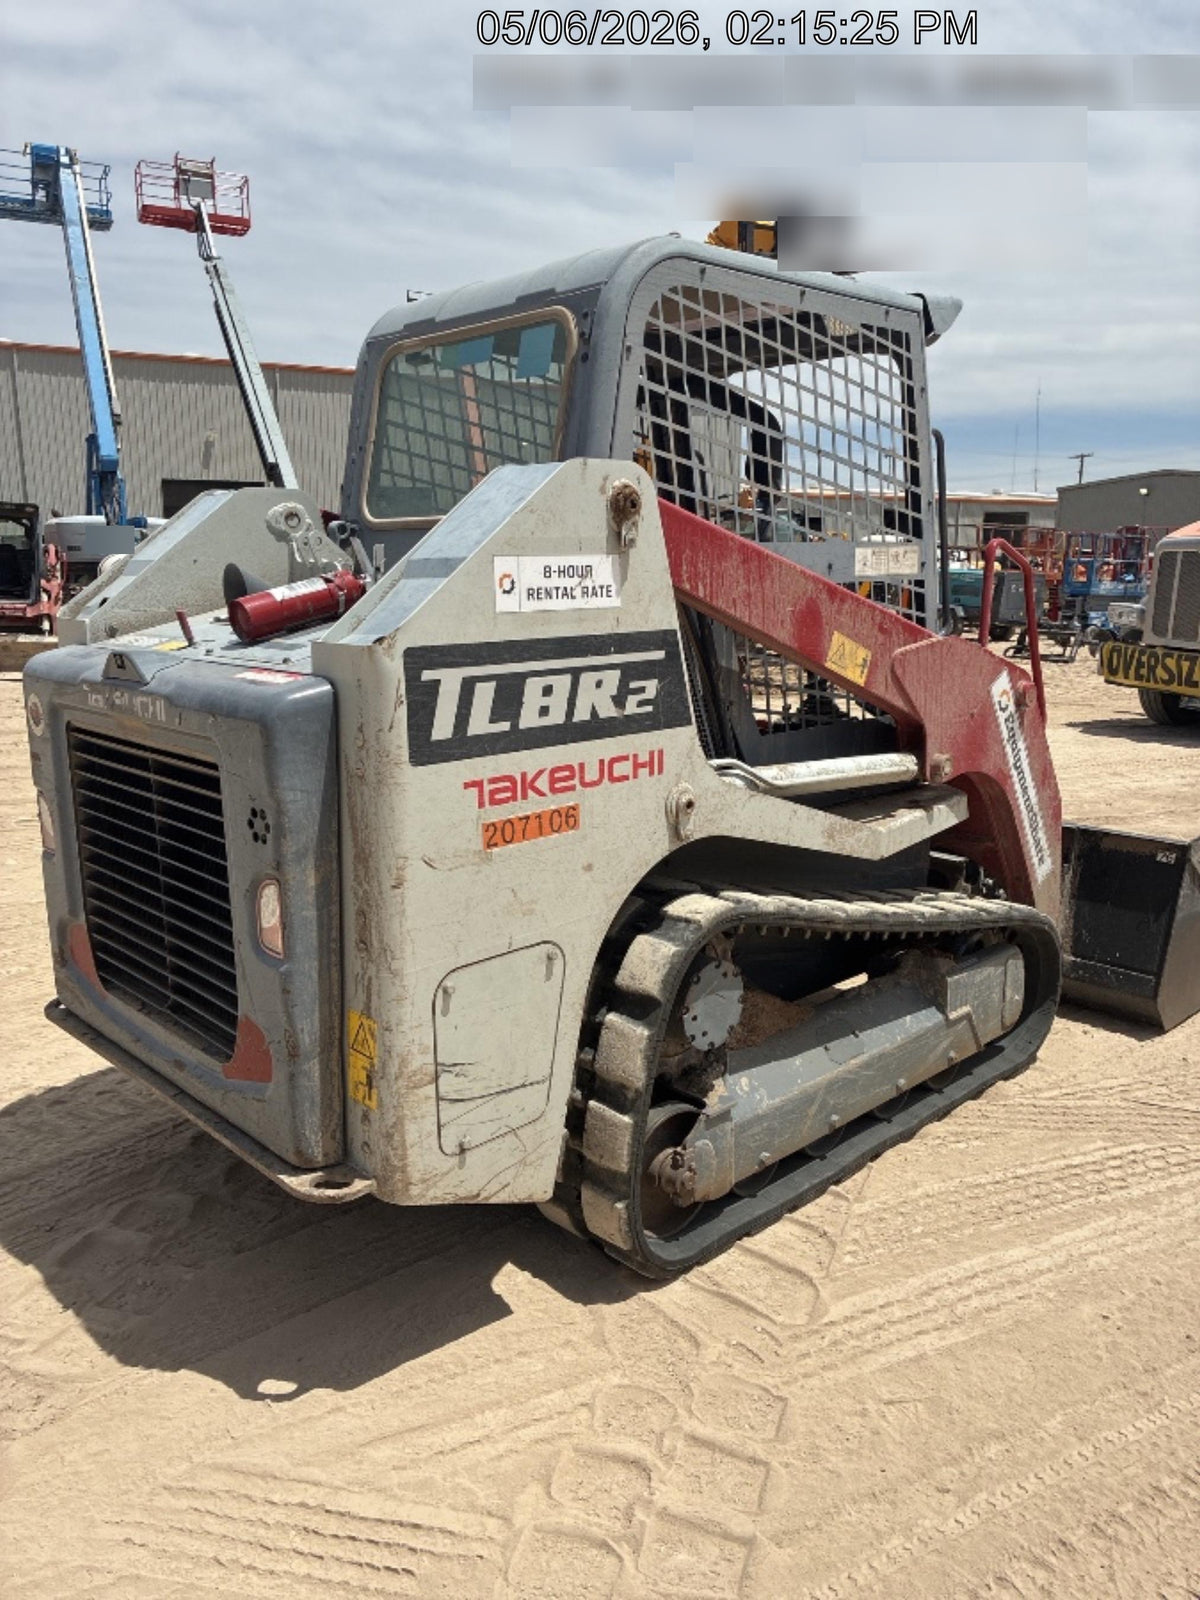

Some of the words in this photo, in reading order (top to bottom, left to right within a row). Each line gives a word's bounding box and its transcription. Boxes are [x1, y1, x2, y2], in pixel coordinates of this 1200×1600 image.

[527, 585, 577, 601] RENTAL
[581, 584, 613, 599] RATE
[543, 564, 593, 579] 8-HOUR
[420, 650, 666, 742] TL8R2
[463, 747, 665, 810] TAKEUCHI
[484, 804, 579, 849] 207106
